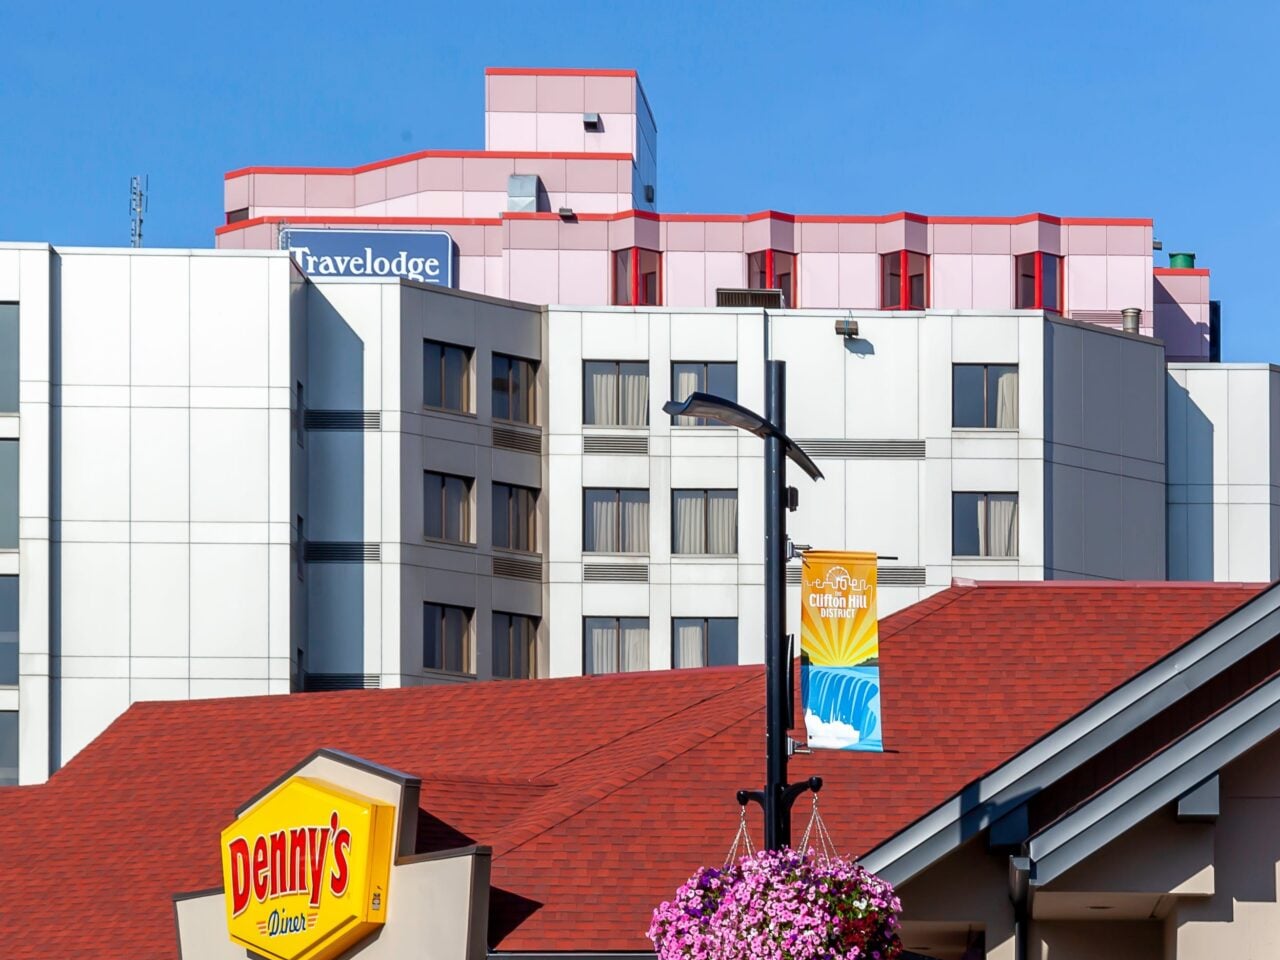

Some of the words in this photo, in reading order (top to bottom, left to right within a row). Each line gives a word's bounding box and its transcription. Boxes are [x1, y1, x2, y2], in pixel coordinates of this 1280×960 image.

[289, 247, 440, 282] Travelodge
[809, 594, 846, 608] Clifton
[848, 595, 867, 608] Hill
[821, 608, 855, 618] DISTRICT
[227, 809, 351, 919] Denny's
[267, 908, 308, 937] Diner
